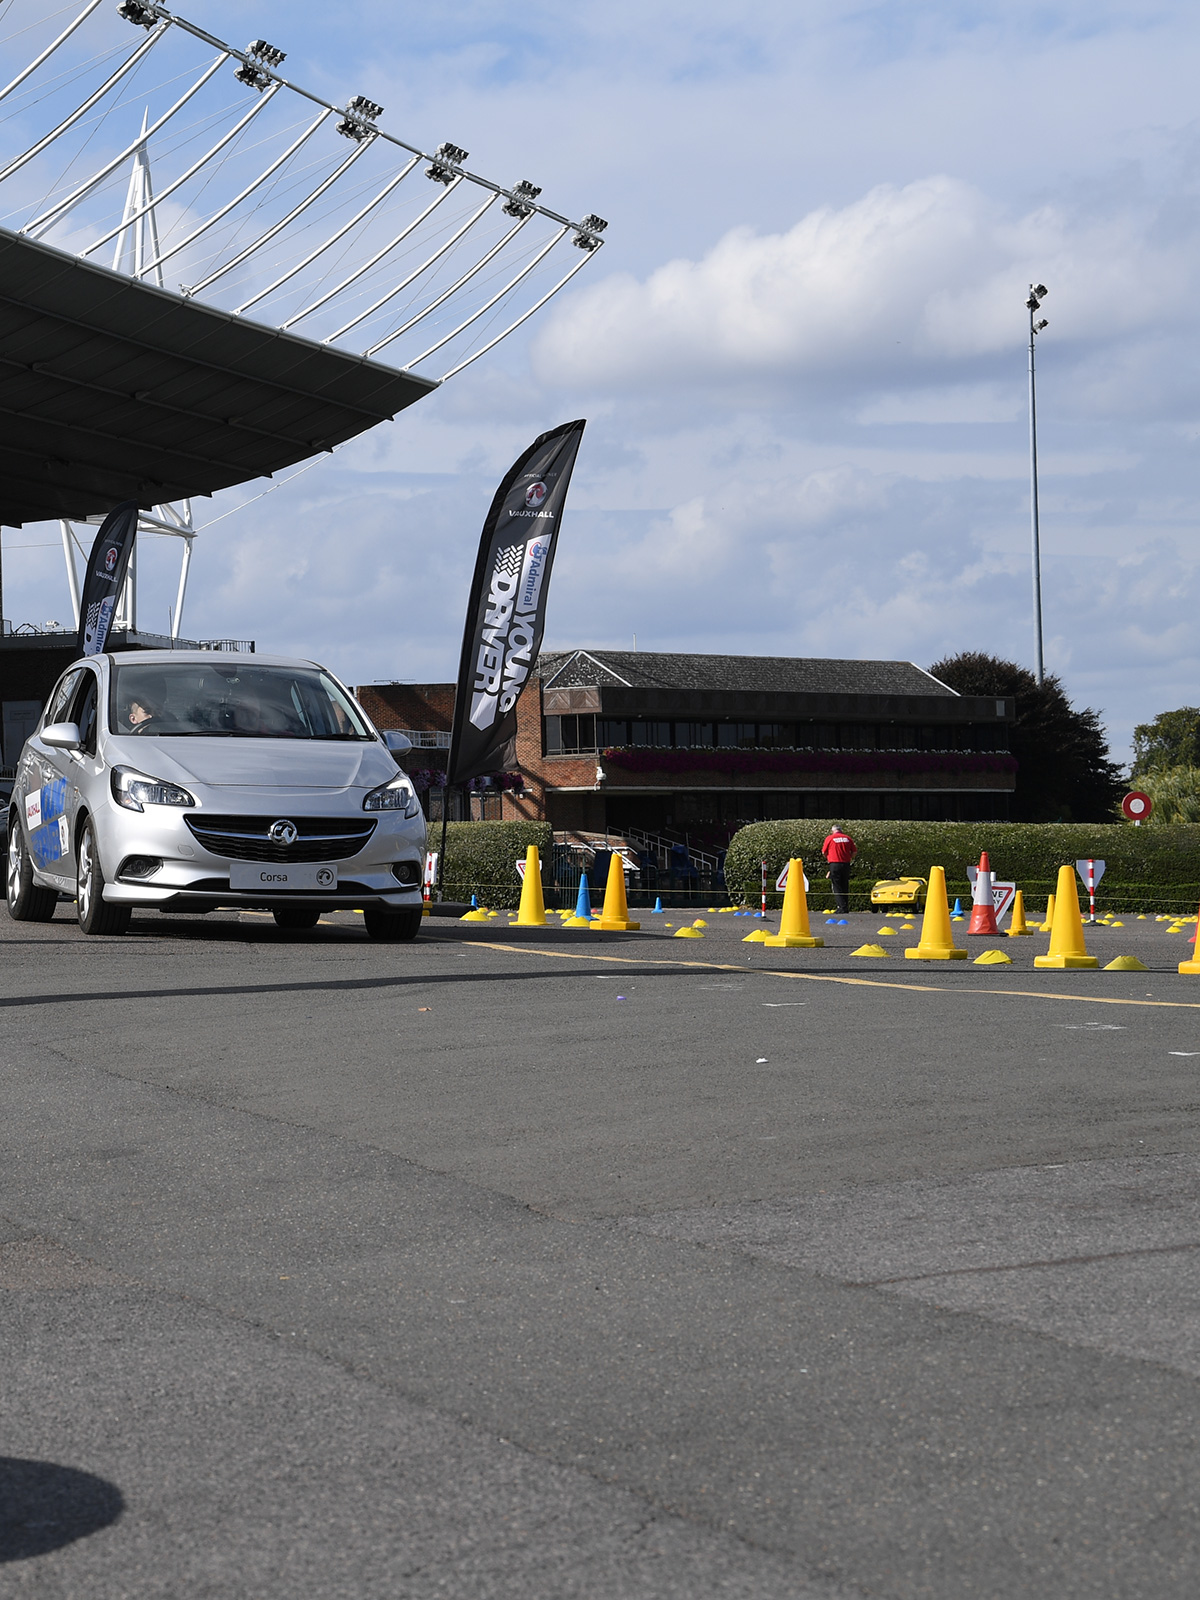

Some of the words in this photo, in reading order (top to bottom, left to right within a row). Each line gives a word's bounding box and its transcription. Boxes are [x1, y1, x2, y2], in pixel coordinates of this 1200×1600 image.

[509, 510, 554, 518] VAUXHALL
[523, 560, 541, 606] Admiral
[95, 617, 108, 655] Admira
[474, 571, 519, 696] DRIVER
[499, 613, 536, 713] YOUNG
[260, 872, 288, 882] Corsa
